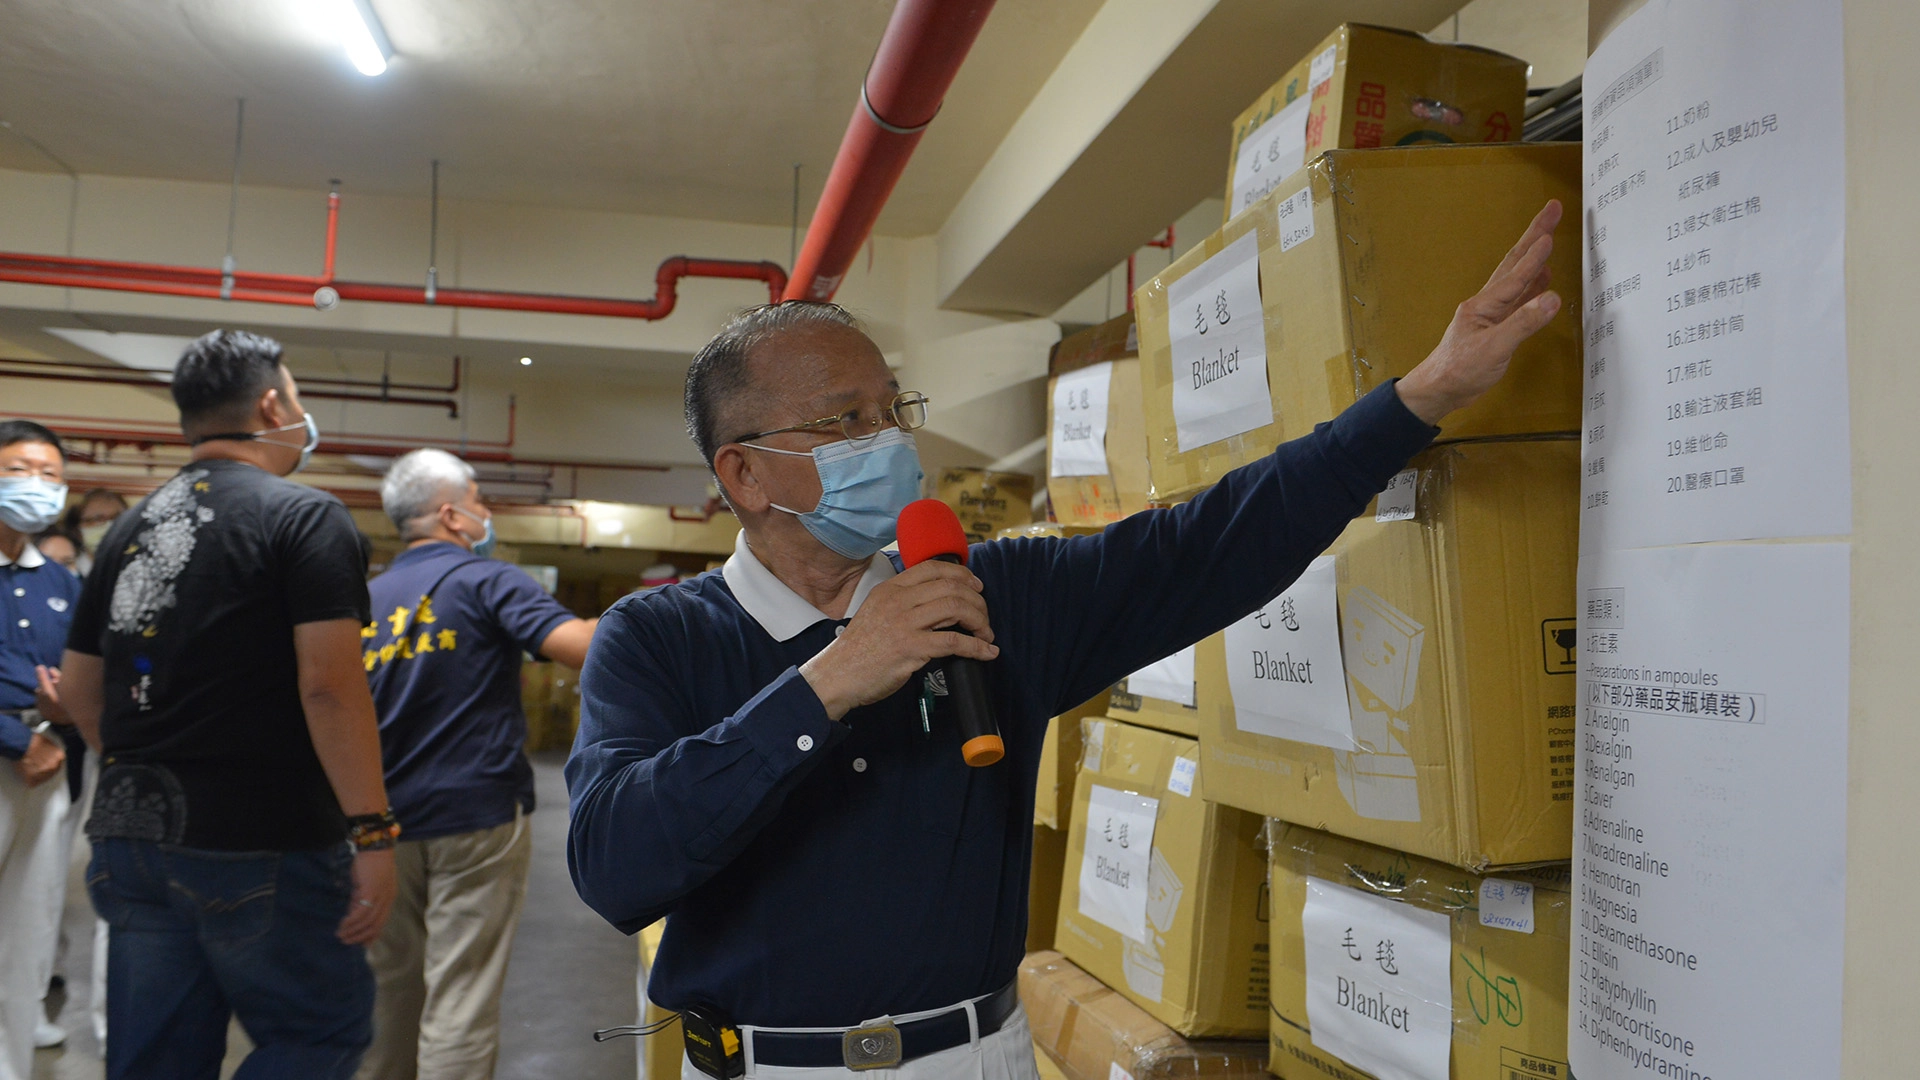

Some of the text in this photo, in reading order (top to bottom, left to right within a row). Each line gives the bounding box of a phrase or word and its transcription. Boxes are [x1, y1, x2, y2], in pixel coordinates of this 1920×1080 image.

[1667, 100, 1710, 136] 11.奶粉
[1667, 113, 1778, 171] 12.成人及嬰幼兒
[1678, 170, 1721, 201] 紙尿褲
[1667, 196, 1761, 242] 13.婦女衛生棉
[1667, 248, 1711, 277] 14.紗布
[1667, 272, 1762, 313] 15.醫療棉花棒
[1194, 289, 1231, 335] 毛毯
[1667, 314, 1744, 349] 16.注射針筒
[1192, 346, 1239, 391] Blanket
[1667, 359, 1713, 385] 17.棉花
[1667, 387, 1763, 421] 18.輸注液套組
[1063, 423, 1092, 442] Blanket
[1667, 431, 1729, 457] 19.維他命
[1667, 466, 1746, 494] 20.醫療口罩
[1252, 650, 1313, 684] Blanket
[1642, 665, 1652, 682] in
[1655, 668, 1719, 687] ampoules
[1096, 854, 1130, 890] Blanket
[1341, 927, 1399, 976] 毛毯
[1592, 915, 1698, 971] Dexamethasone
[1336, 975, 1410, 1033] Blanket
[1579, 960, 1657, 1015] 12. Platyphyllin
[1579, 985, 1590, 1008] 13.
[1579, 1010, 1713, 1080] 14. Diphenhydramin
[1520, 1057, 1558, 1077] 商品條碼
